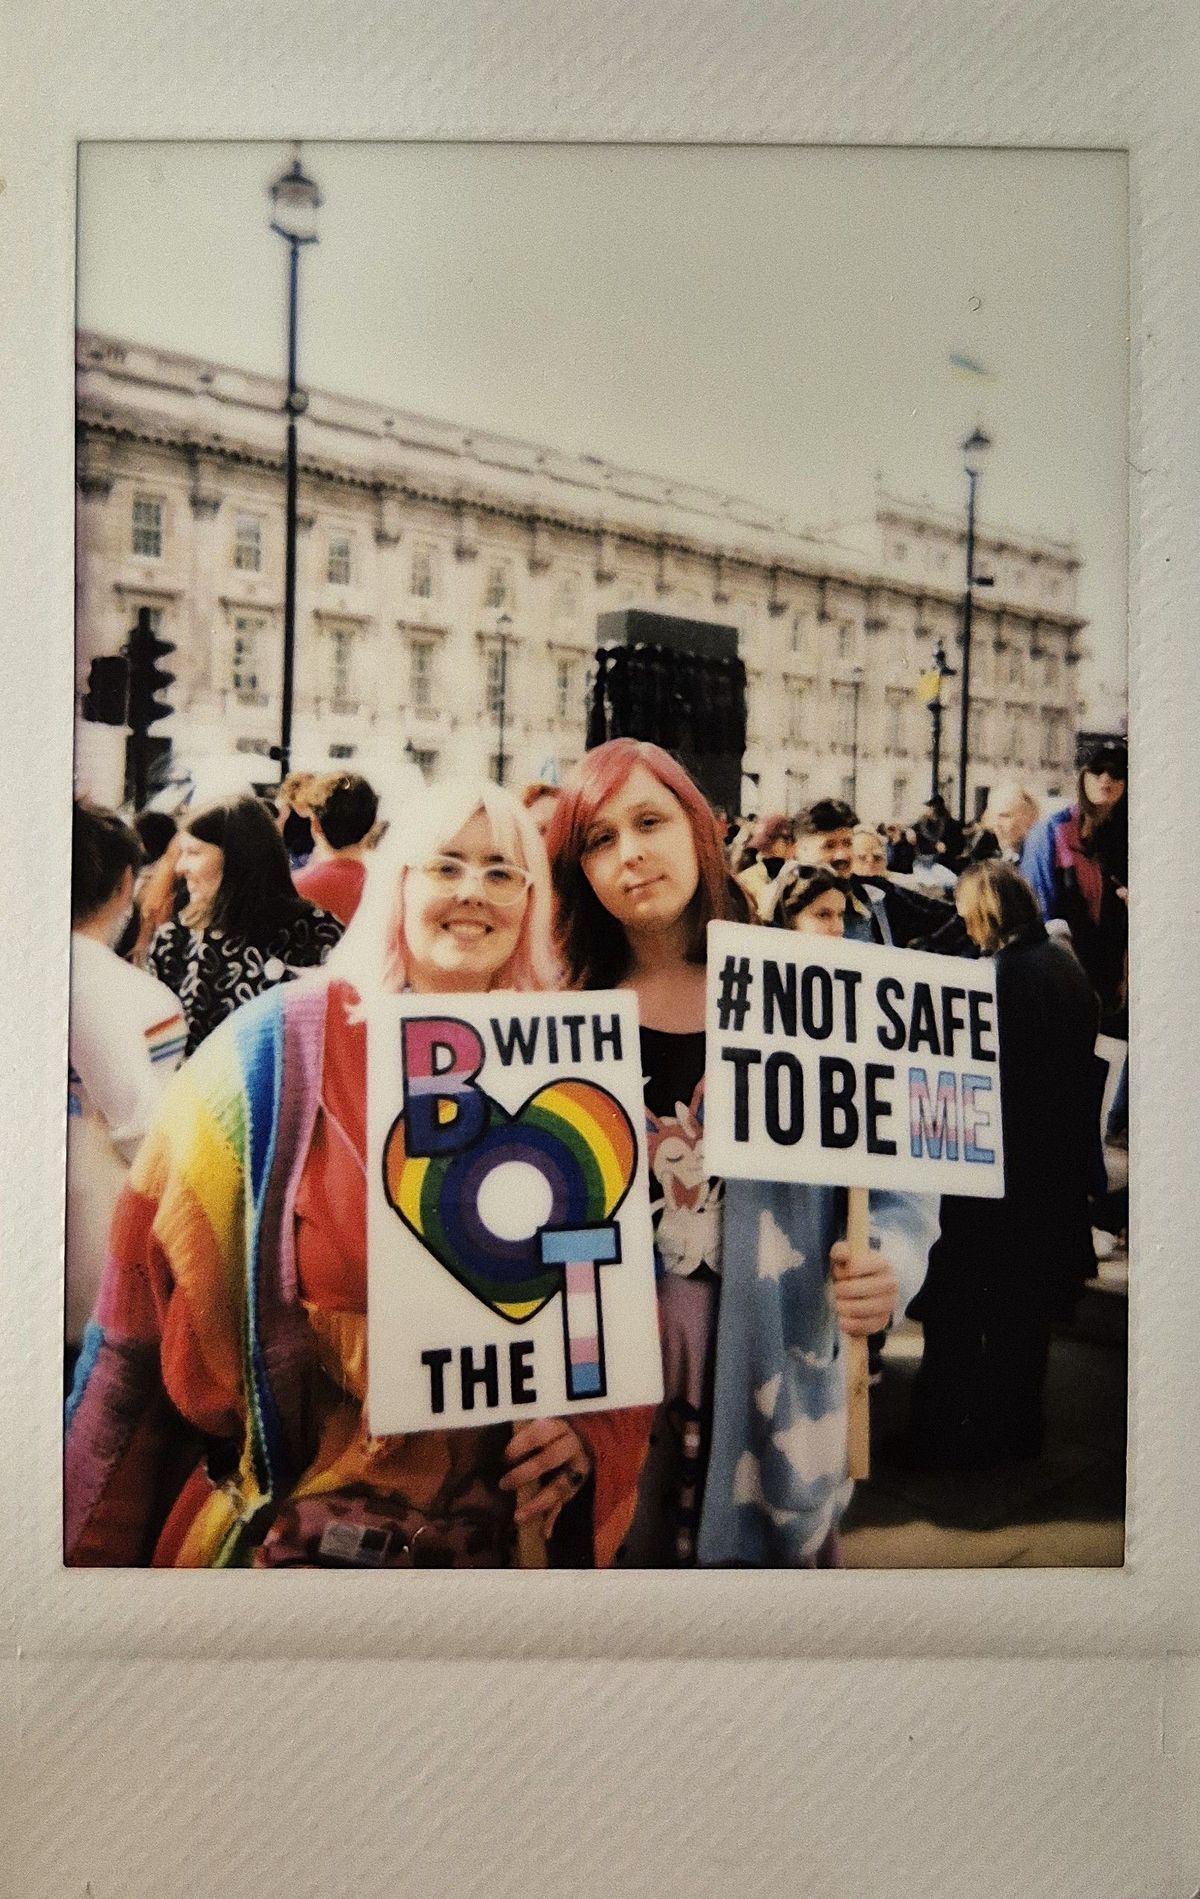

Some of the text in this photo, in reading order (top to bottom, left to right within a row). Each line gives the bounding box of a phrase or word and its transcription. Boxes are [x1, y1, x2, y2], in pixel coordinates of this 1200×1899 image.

[716, 954, 997, 1063] #NOT SAFE
[400, 1013, 623, 1159] B WITH
[720, 1046, 995, 1165] TO BE ME
[421, 1220, 622, 1414] THE T
